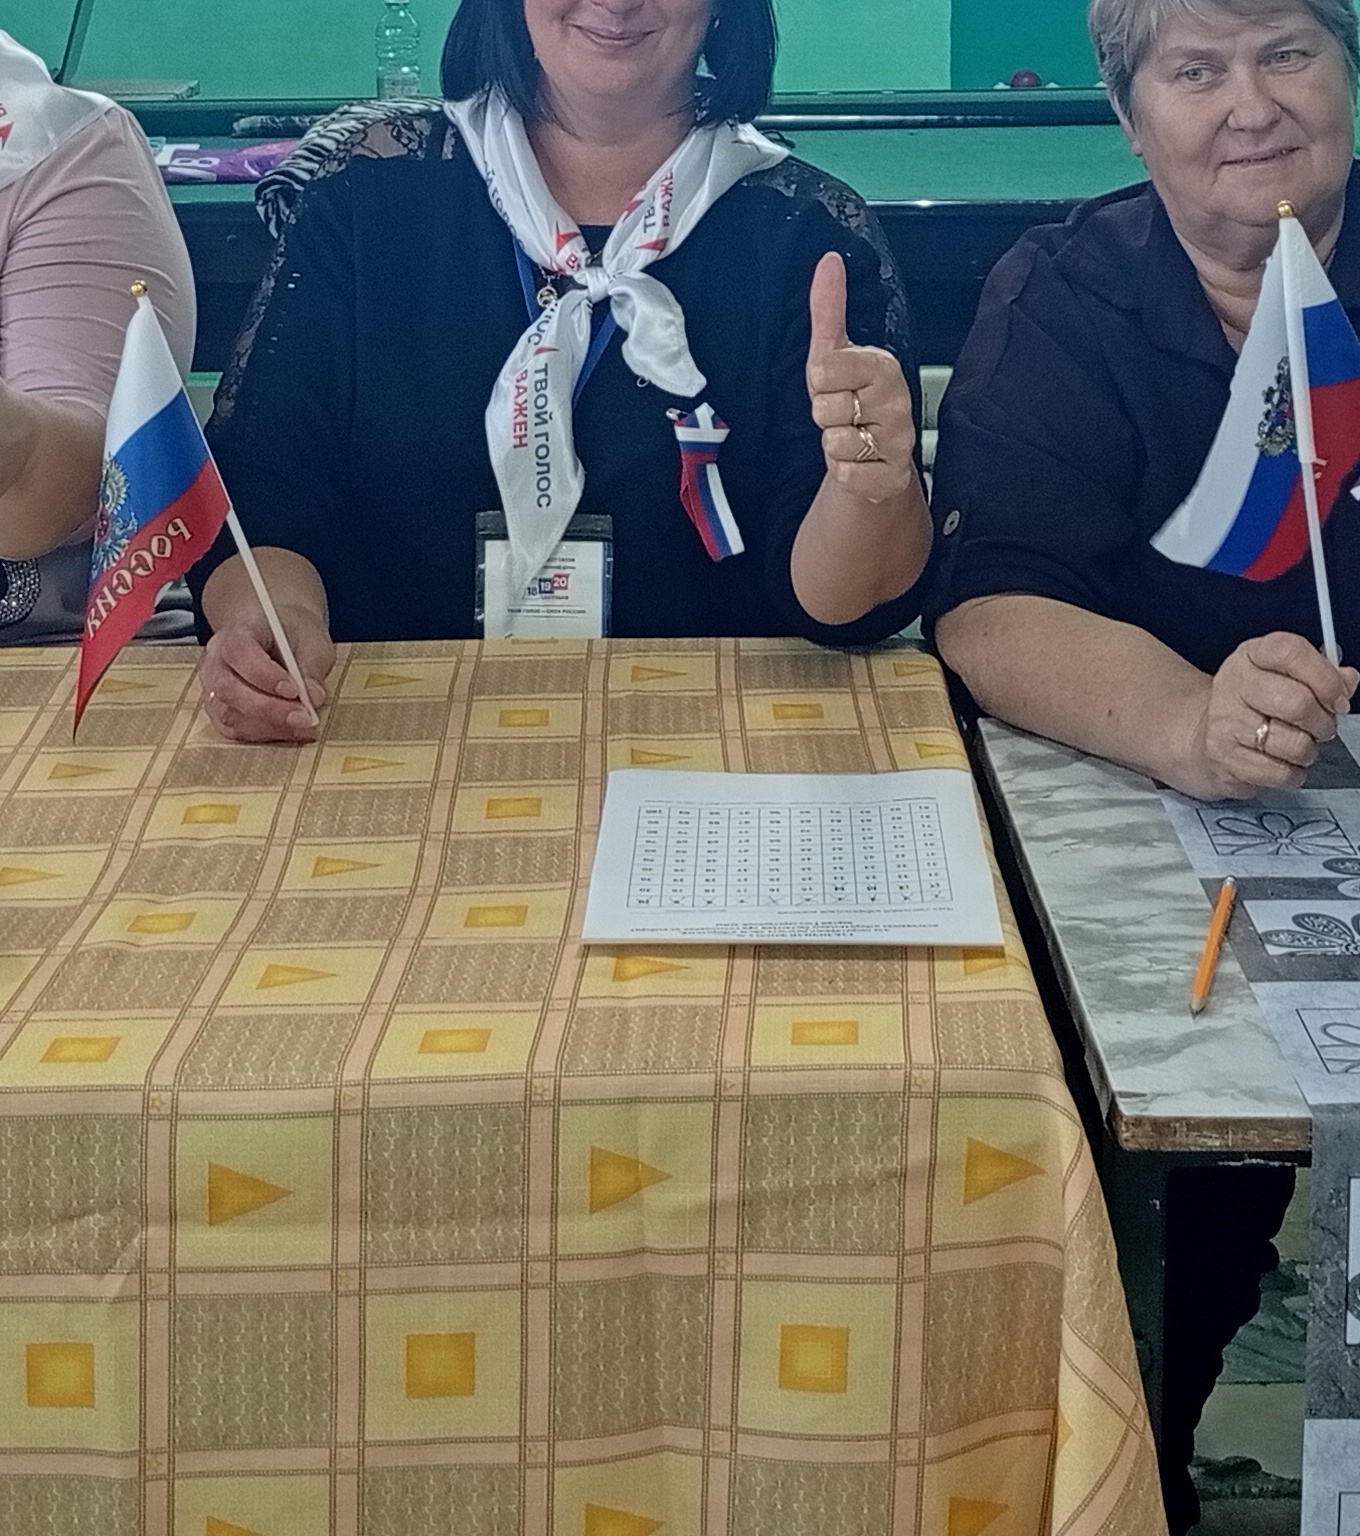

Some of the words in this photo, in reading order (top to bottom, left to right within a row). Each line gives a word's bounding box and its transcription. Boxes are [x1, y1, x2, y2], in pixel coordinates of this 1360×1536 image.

[513, 368, 529, 449] ВАЖЕН
[534, 362, 553, 426] ТВОЙ
[535, 431, 552, 509] ГОЛОС
[527, 586, 538, 596] 18
[553, 576, 567, 587] 20
